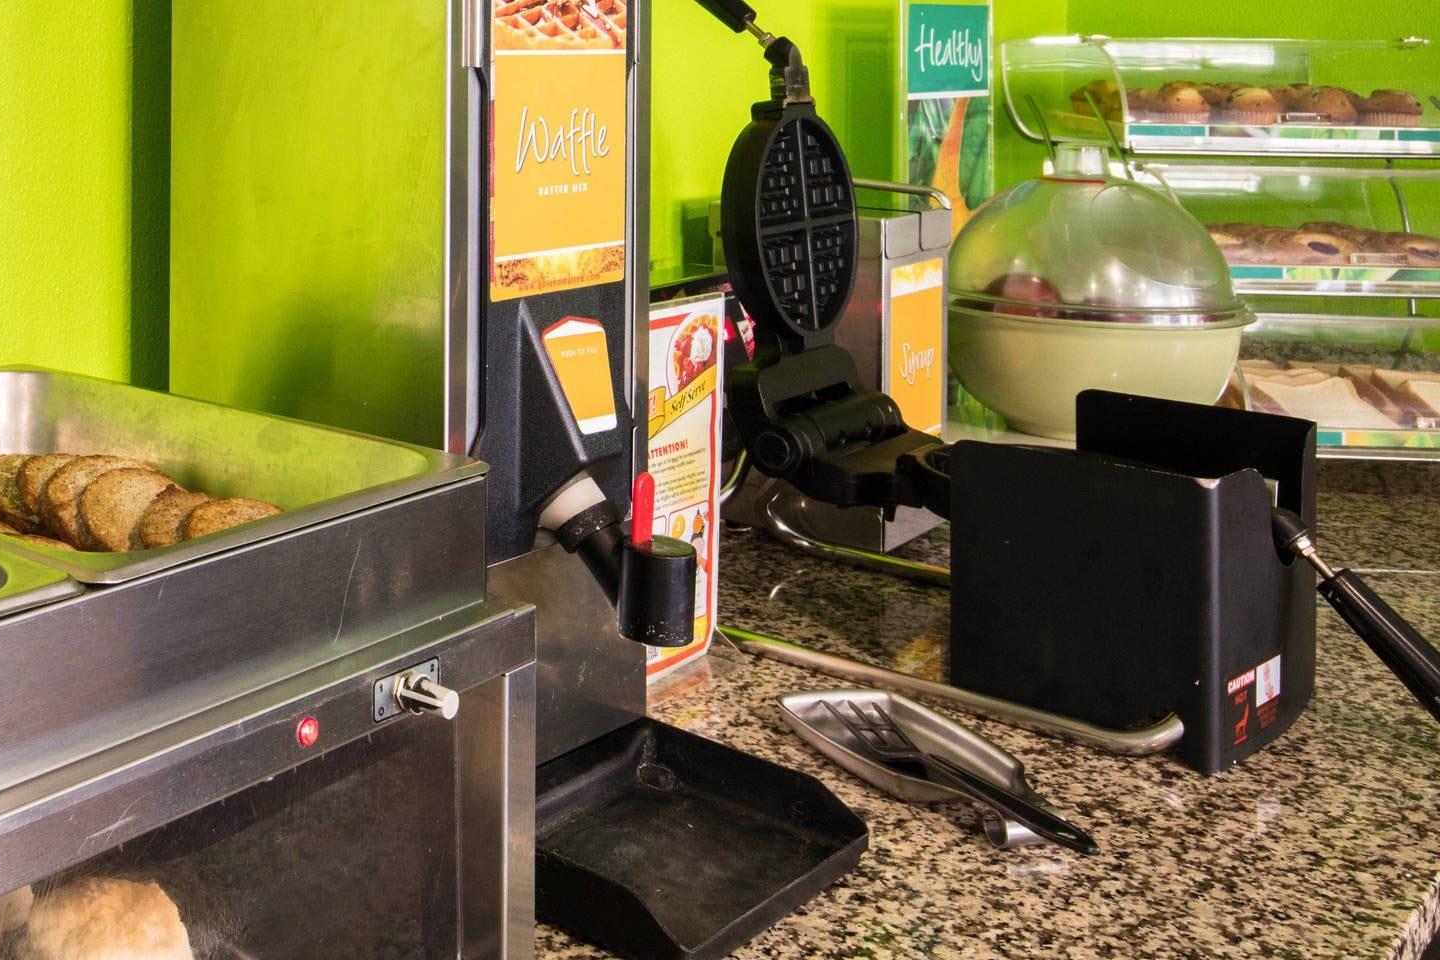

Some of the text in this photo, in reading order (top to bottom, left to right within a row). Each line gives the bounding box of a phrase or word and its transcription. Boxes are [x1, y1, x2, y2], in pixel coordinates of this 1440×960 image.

[914, 23, 983, 82] Healthy
[515, 106, 609, 176] Waffle
[538, 183, 588, 196] BATTER MIX
[899, 342, 935, 385] Syrup
[670, 391, 688, 415] Self
[687, 380, 706, 404] Serve
[430, 663, 435, 673] 2
[1227, 668, 1255, 695] CAUTION
[1235, 690, 1248, 706] HOT
